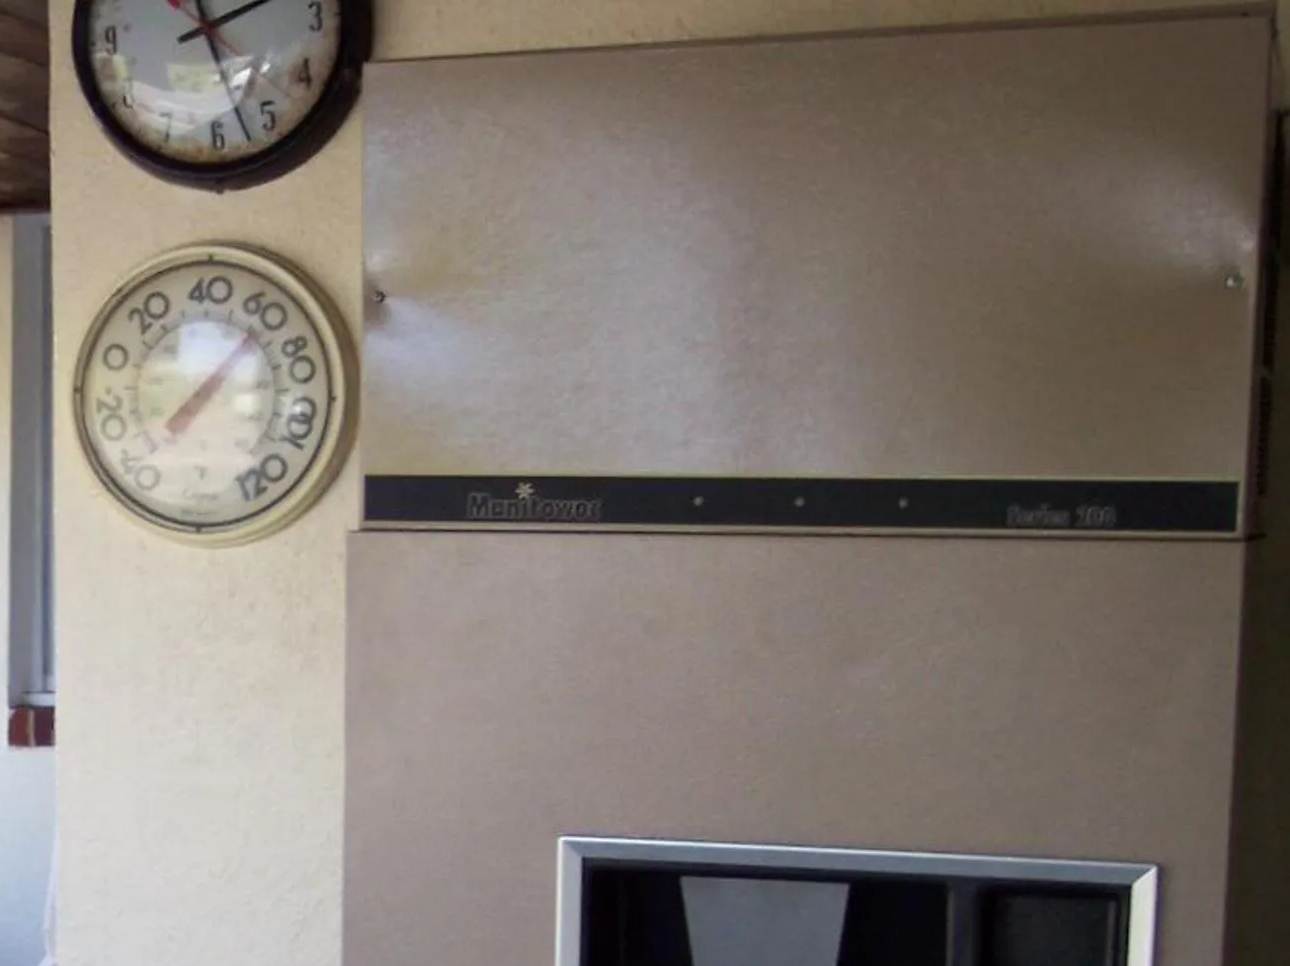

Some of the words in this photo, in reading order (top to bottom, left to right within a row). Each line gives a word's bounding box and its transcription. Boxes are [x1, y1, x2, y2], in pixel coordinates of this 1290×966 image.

[309, 3, 323, 32] 3
[105, 25, 118, 56] 9
[297, 58, 312, 89] 4
[261, 101, 276, 132] 5
[212, 121, 226, 151] 6
[188, 276, 233, 305] 40
[128, 291, 170, 336] 20
[242, 292, 288, 331] 60
[102, 343, 129, 371] 0
[281, 336, 317, 384] 80
[281, 396, 318, 450] 100
[235, 453, 288, 502] 120
